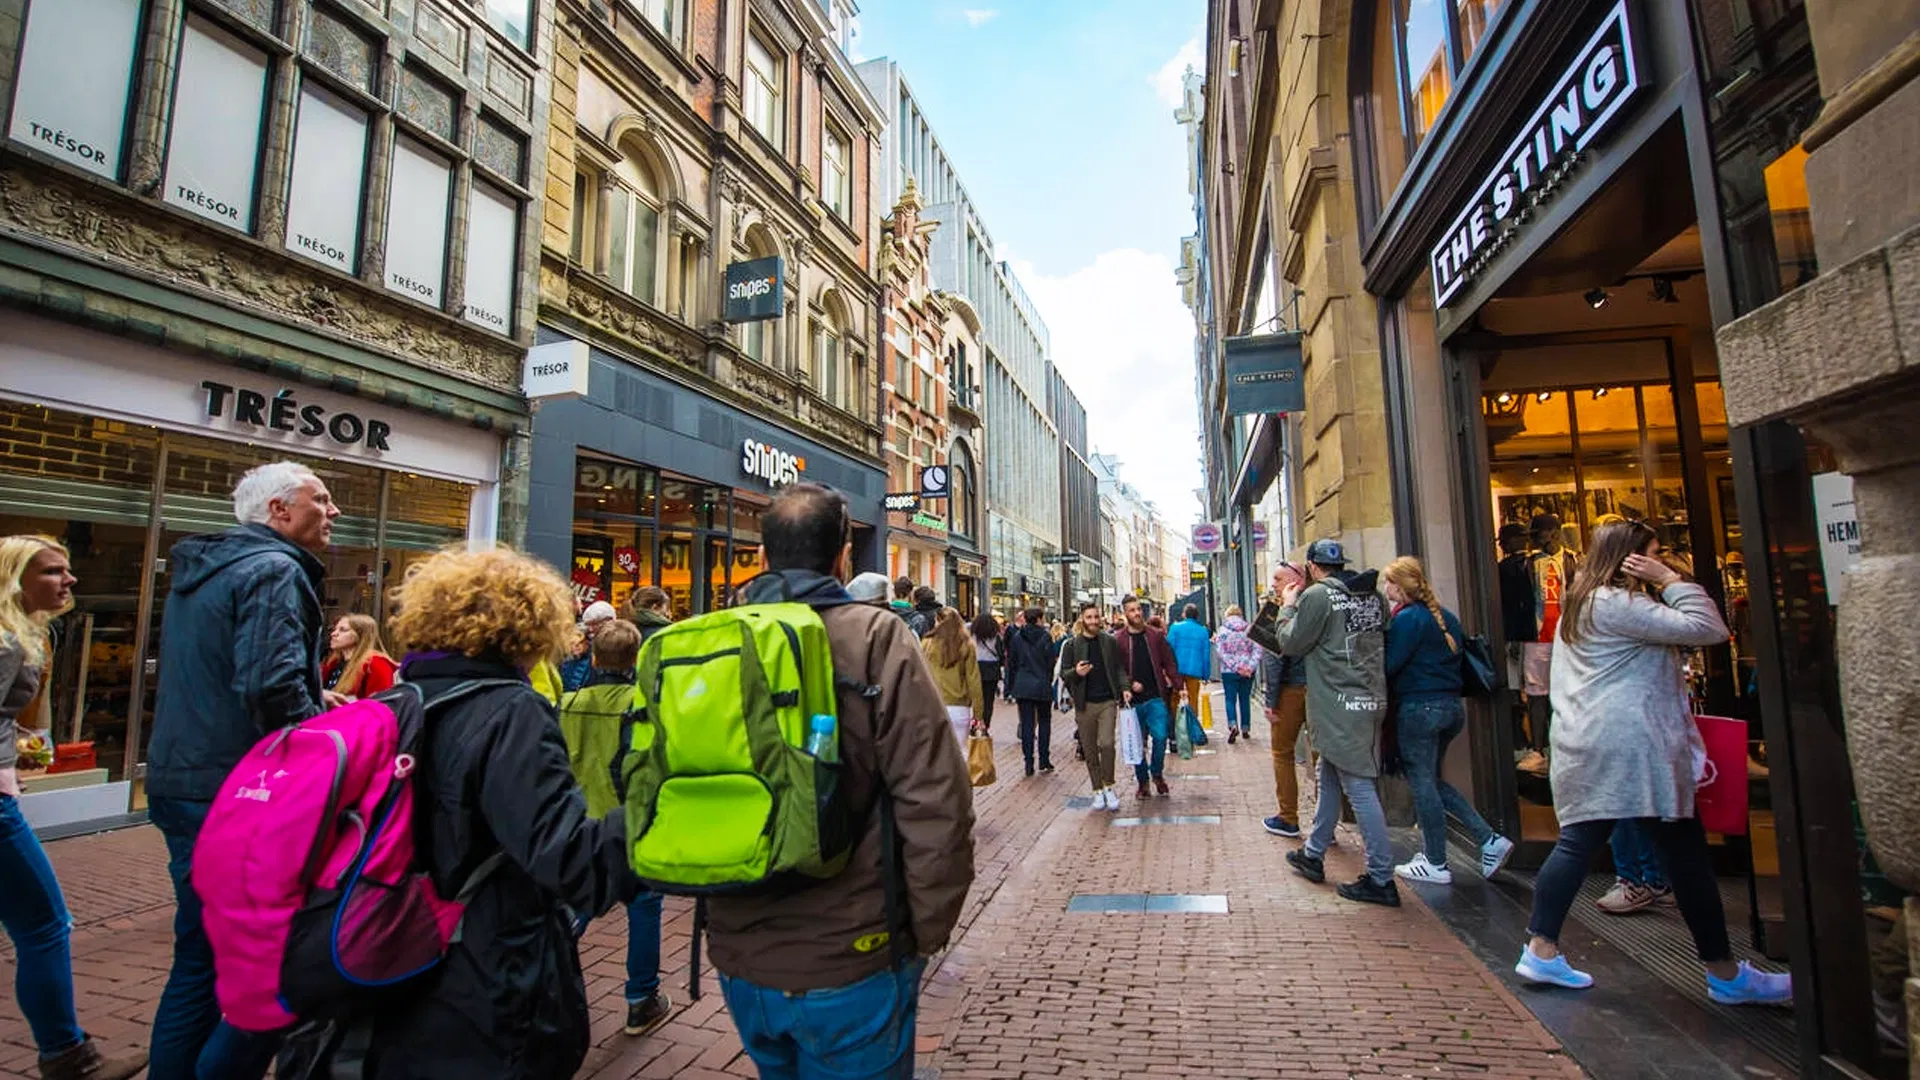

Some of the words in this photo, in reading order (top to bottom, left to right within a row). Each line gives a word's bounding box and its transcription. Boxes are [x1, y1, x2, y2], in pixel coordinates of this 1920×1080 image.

[30, 121, 107, 166] TRÉSOR
[1437, 204, 1487, 286] THE
[1493, 45, 1619, 221] STING
[177, 185, 239, 221] TRÉSOR
[296, 234, 345, 263] TRÉSOR
[392, 273, 434, 298] TRÉSOR
[470, 305, 504, 327] TRÉSOR
[532, 361, 570, 377] TRÉSOR
[202, 380, 391, 452] TRÉSOR
[570, 582, 600, 602] ALE
